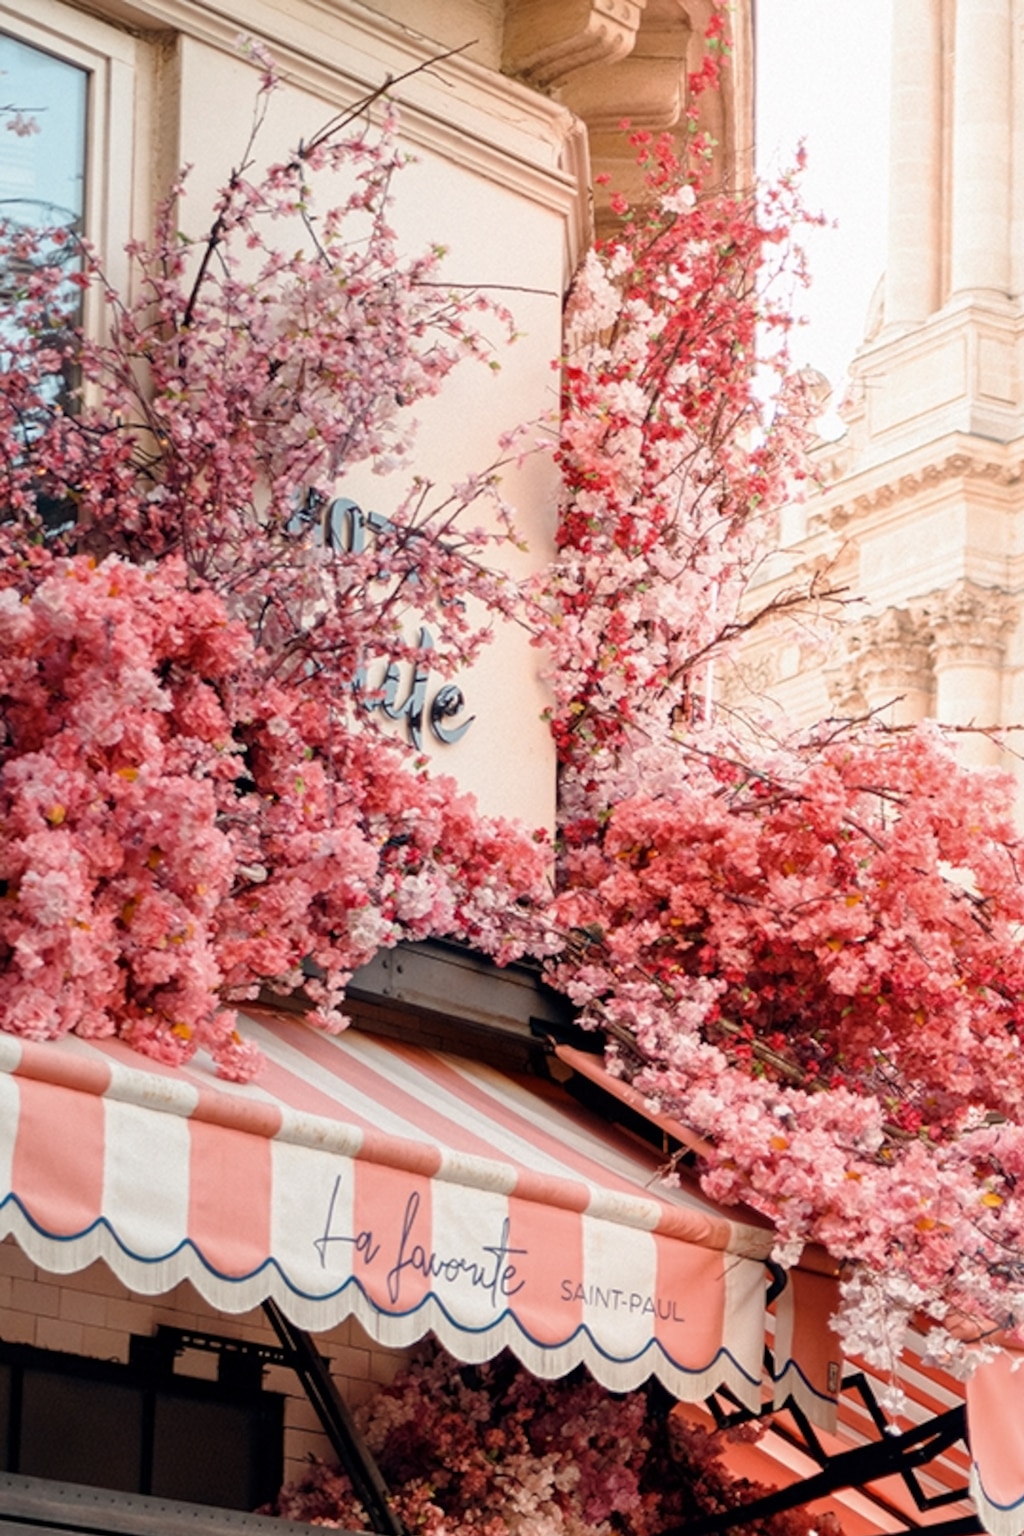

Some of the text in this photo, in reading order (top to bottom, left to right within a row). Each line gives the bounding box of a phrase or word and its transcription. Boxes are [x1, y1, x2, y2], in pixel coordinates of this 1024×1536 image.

[313, 1174, 686, 1323] La favorite SAINT-PAUL
